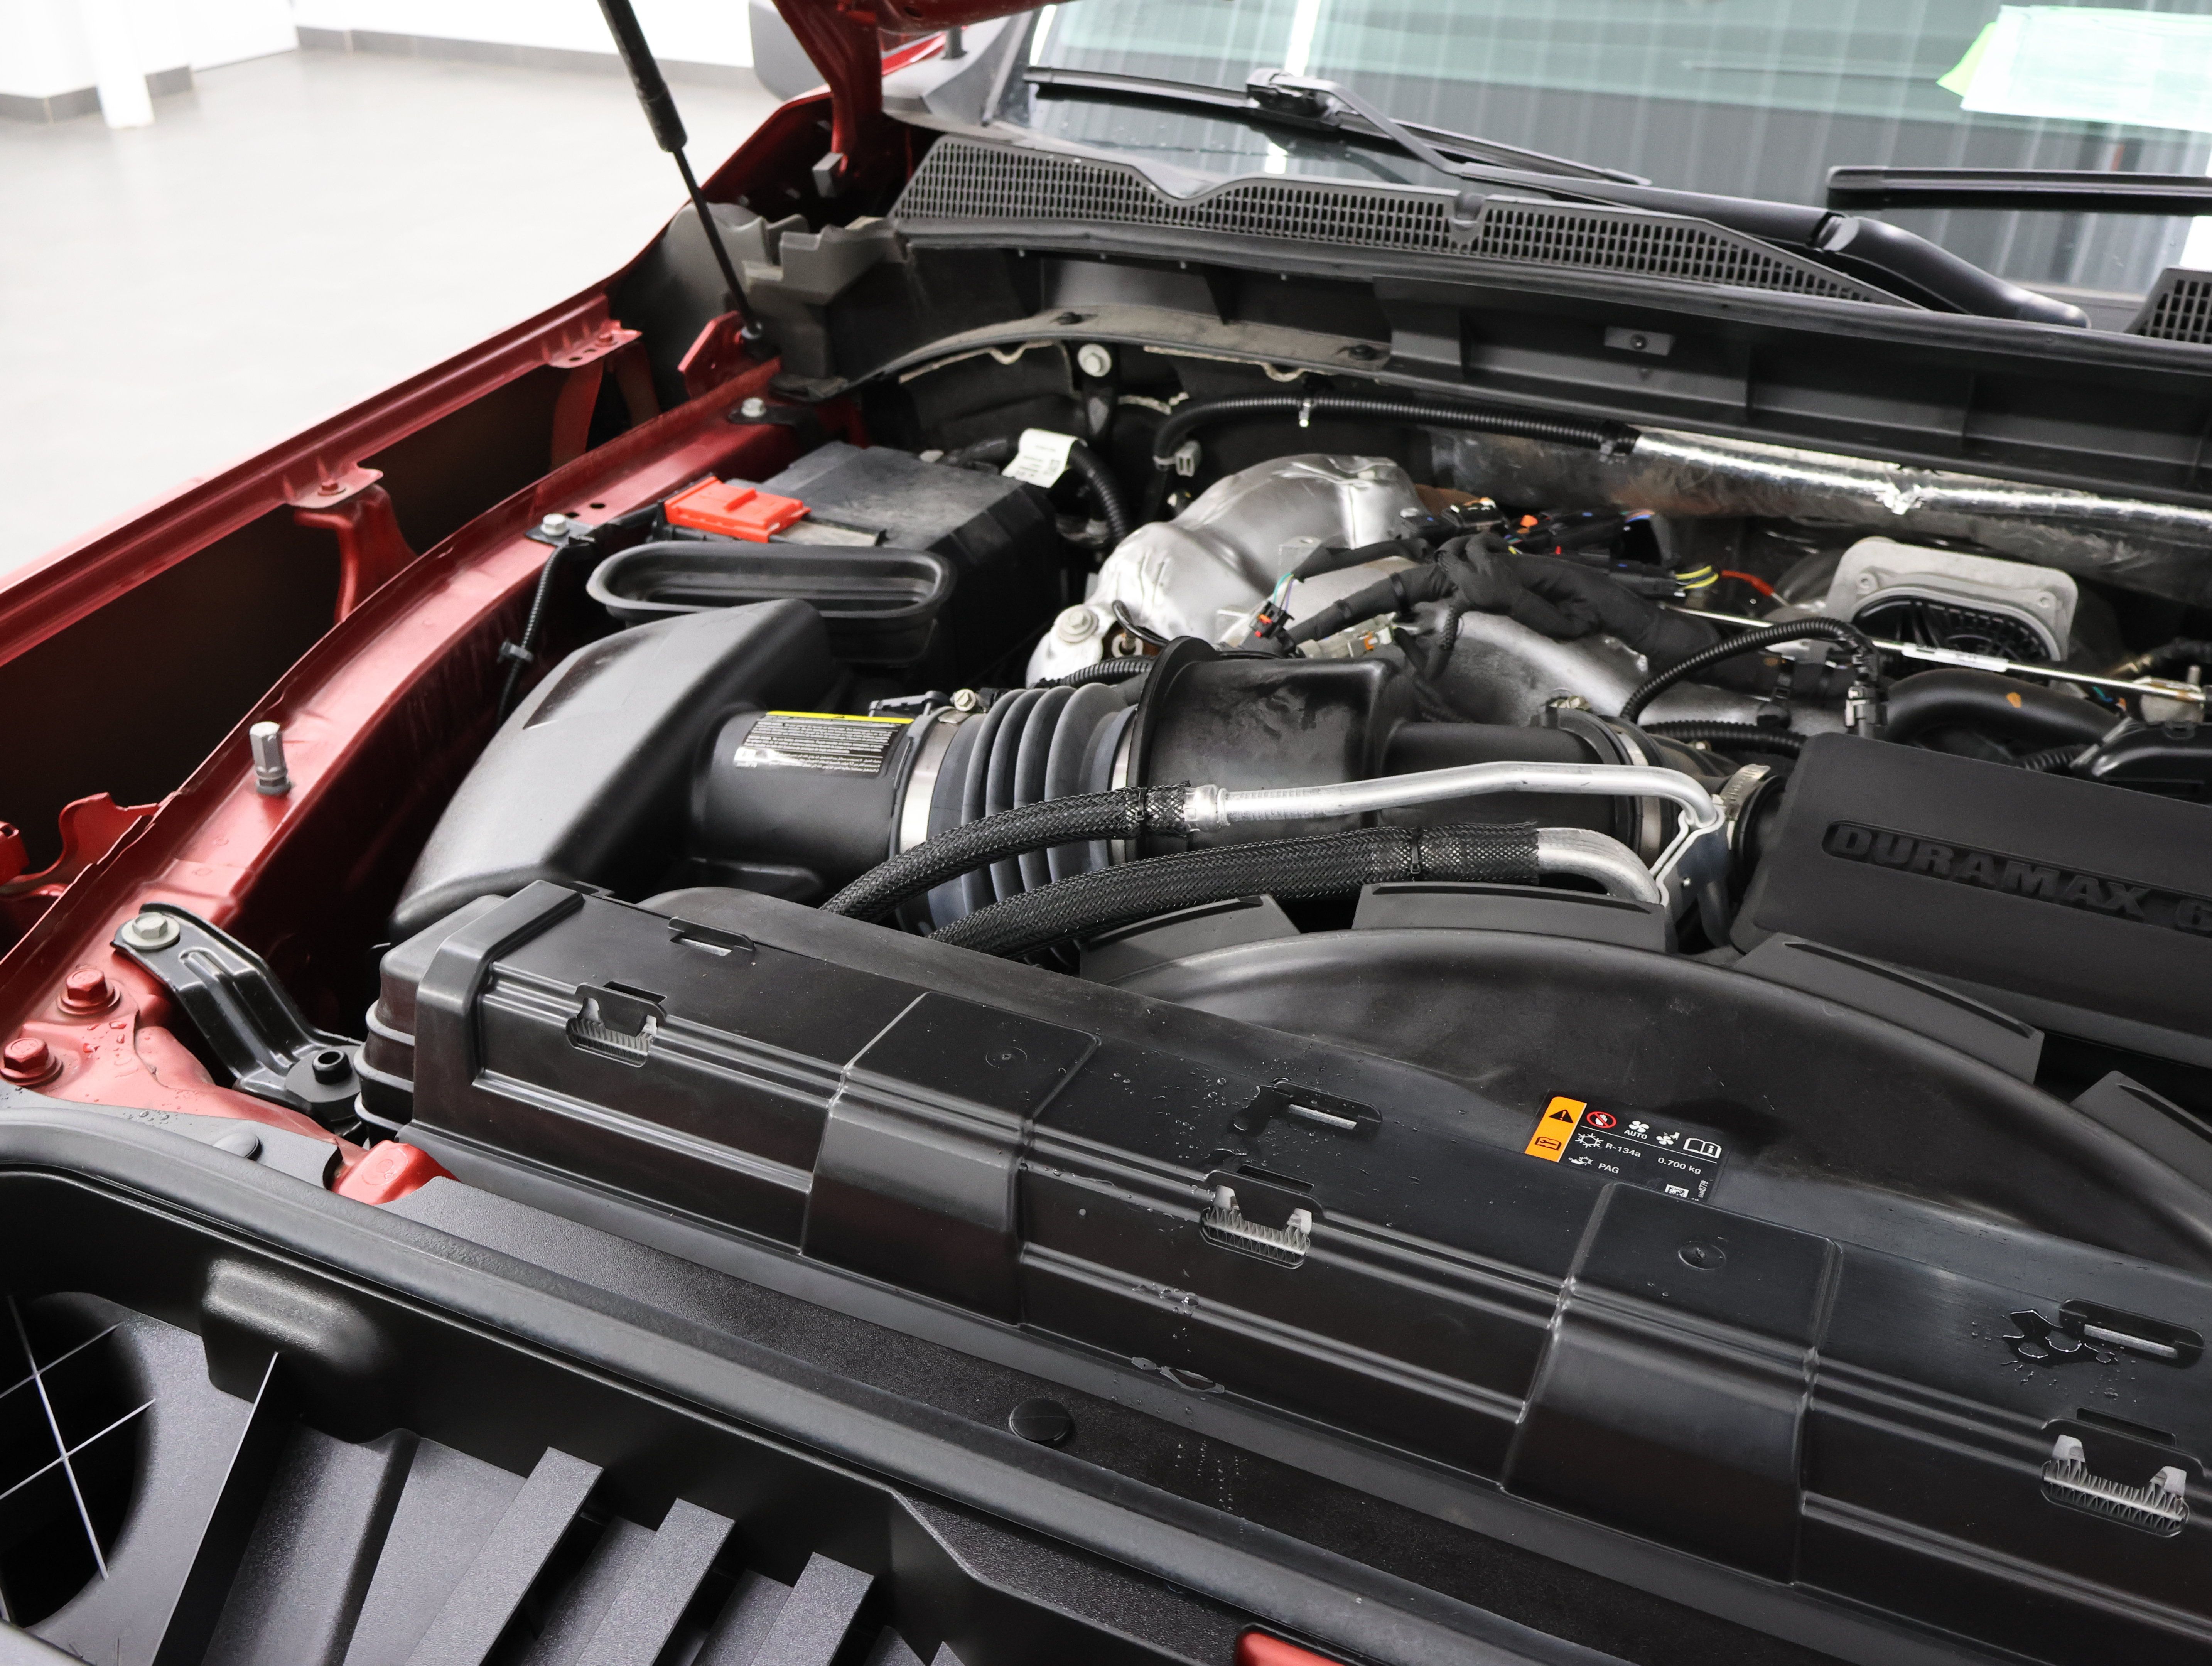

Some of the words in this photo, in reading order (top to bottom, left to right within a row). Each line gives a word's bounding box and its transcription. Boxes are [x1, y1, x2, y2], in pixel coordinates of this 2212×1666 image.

[1832, 825, 2151, 922] DURAMAX
[1623, 1130, 1648, 1140] AUTO
[1605, 1143, 1641, 1157] R-134a
[1598, 1163, 1620, 1174] PAG
[1658, 1157, 1686, 1169] 0.700
[1688, 1165, 1701, 1175] kg
